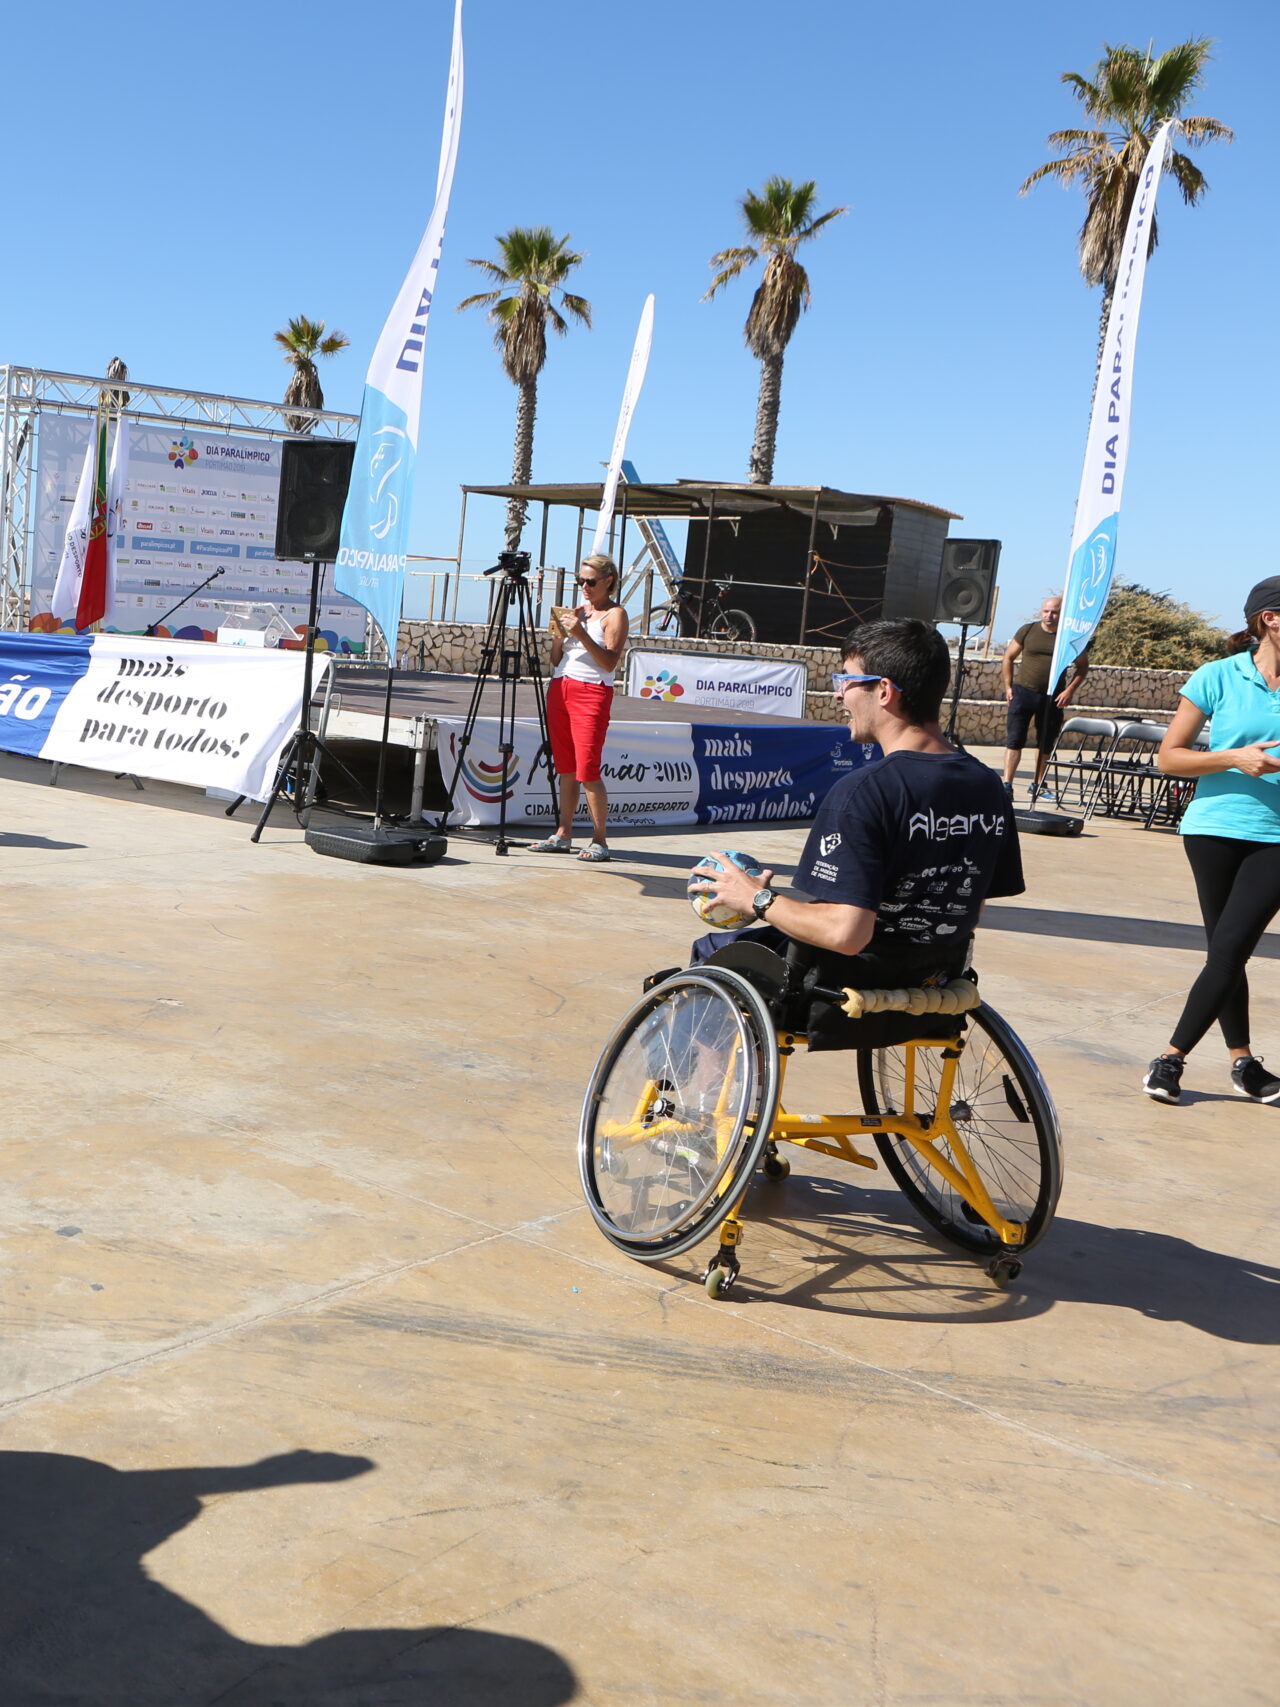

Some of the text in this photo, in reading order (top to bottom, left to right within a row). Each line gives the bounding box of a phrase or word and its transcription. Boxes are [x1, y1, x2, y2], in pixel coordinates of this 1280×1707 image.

[206, 445, 220, 456] DIA
[1101, 433, 1118, 495] DIA
[116, 655, 189, 678] mais
[96, 680, 228, 720] desporto
[696, 679, 793, 697] DIA PARALÍMPICO
[78, 718, 250, 759] para todos!
[704, 732, 752, 757] mais
[653, 760, 693, 783] 2019
[710, 763, 794, 794] desporto
[621, 802, 635, 814] DO
[637, 800, 690, 813] DESPORTO
[707, 791, 815, 825] para todos!
[908, 807, 1005, 842] Algarve
